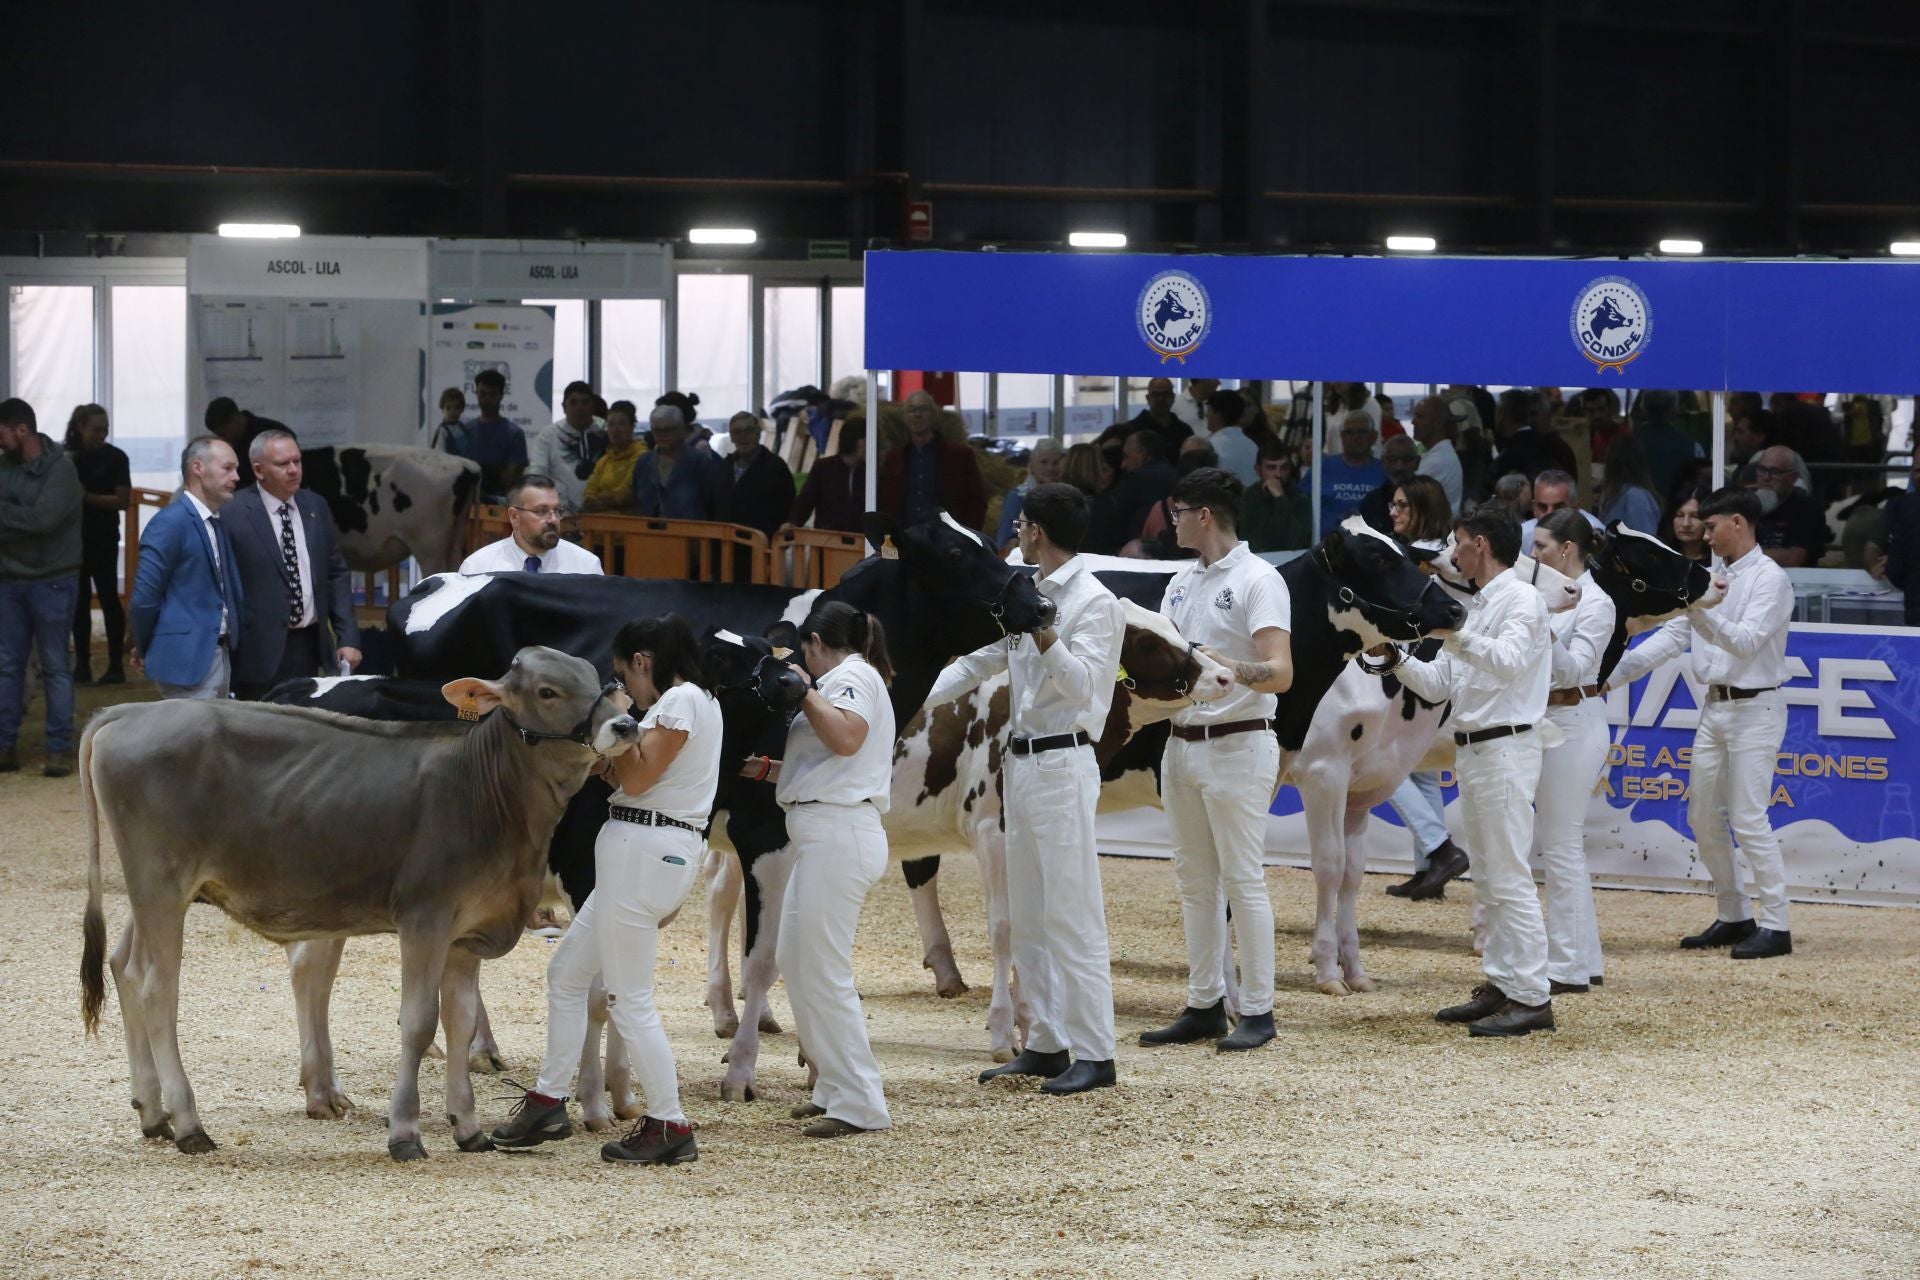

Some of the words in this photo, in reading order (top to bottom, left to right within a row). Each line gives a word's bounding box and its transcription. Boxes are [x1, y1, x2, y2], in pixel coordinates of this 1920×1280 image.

[267, 260, 306, 274] ASCOL
[316, 261, 341, 275] LILA
[529, 265, 556, 279] ASCOL
[561, 265, 579, 279] LILA
[1146, 321, 1201, 348] CONAFE
[1581, 330, 1641, 357] CONAFE
[1607, 744, 1646, 767] DE
